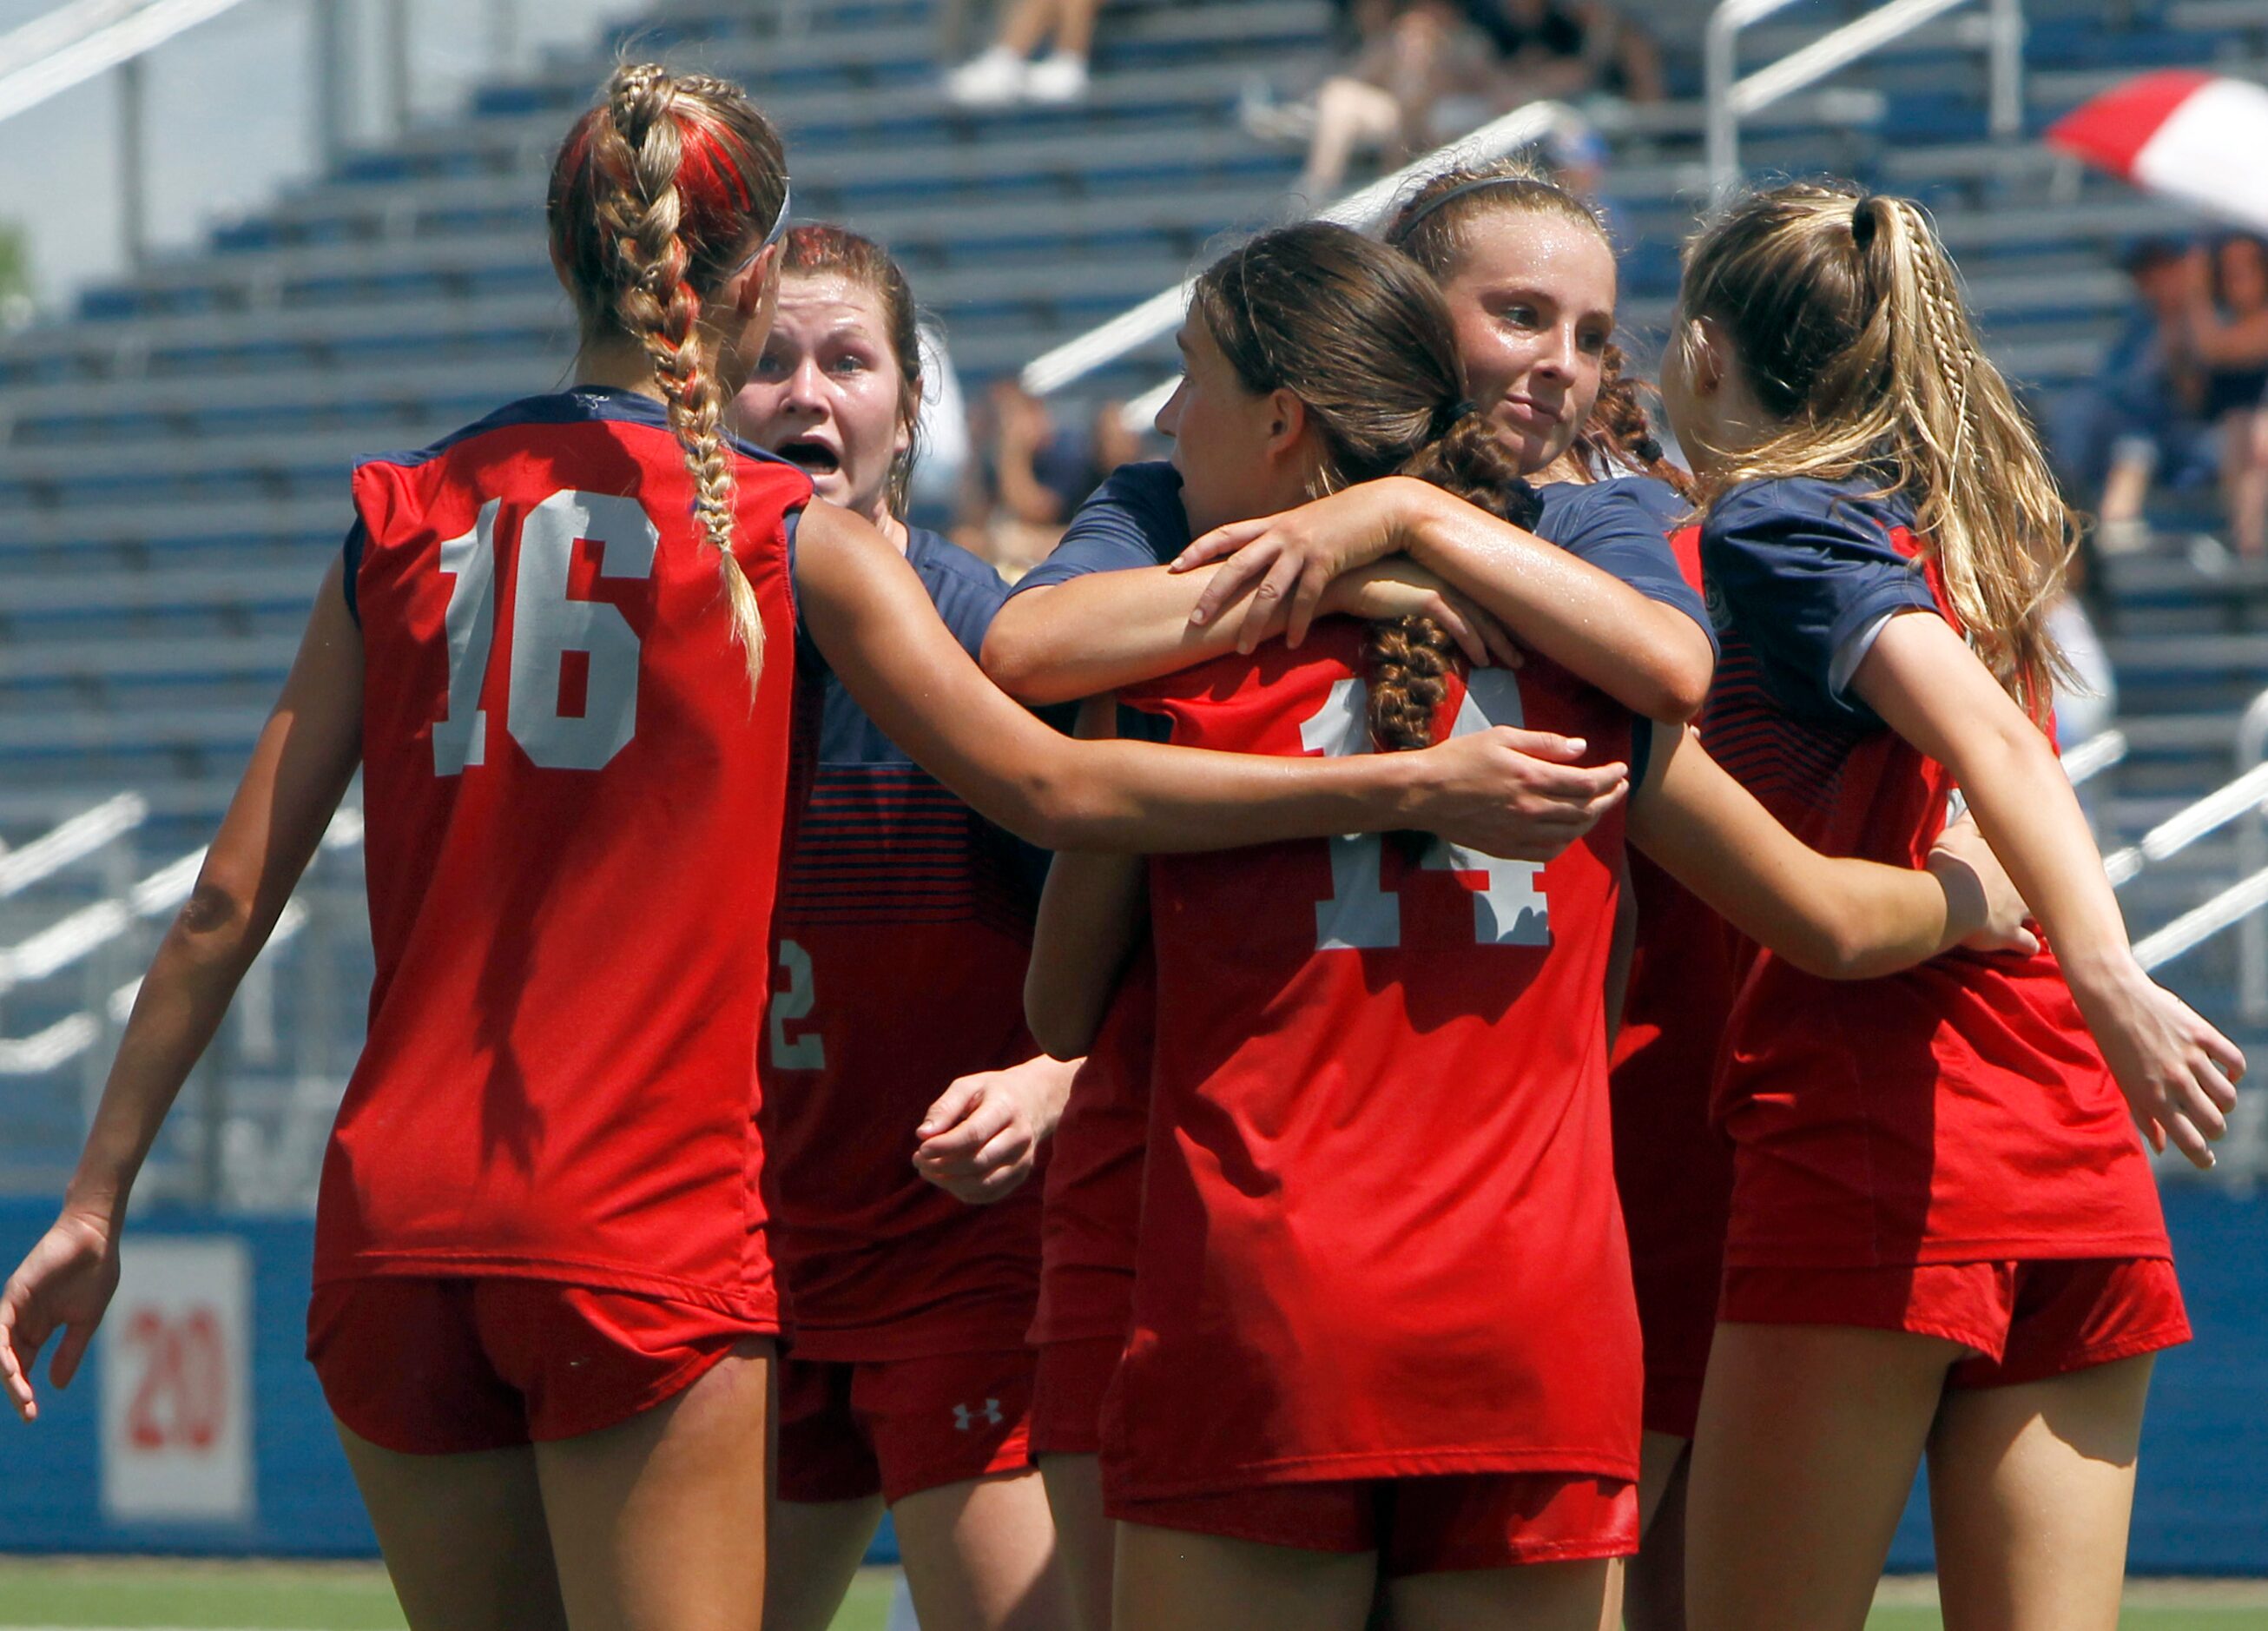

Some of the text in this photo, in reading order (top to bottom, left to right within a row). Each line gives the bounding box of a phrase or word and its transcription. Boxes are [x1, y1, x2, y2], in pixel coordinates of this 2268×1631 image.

[432, 489, 660, 776] 16
[769, 939, 825, 1070] 2
[127, 1305, 227, 1454] 20
